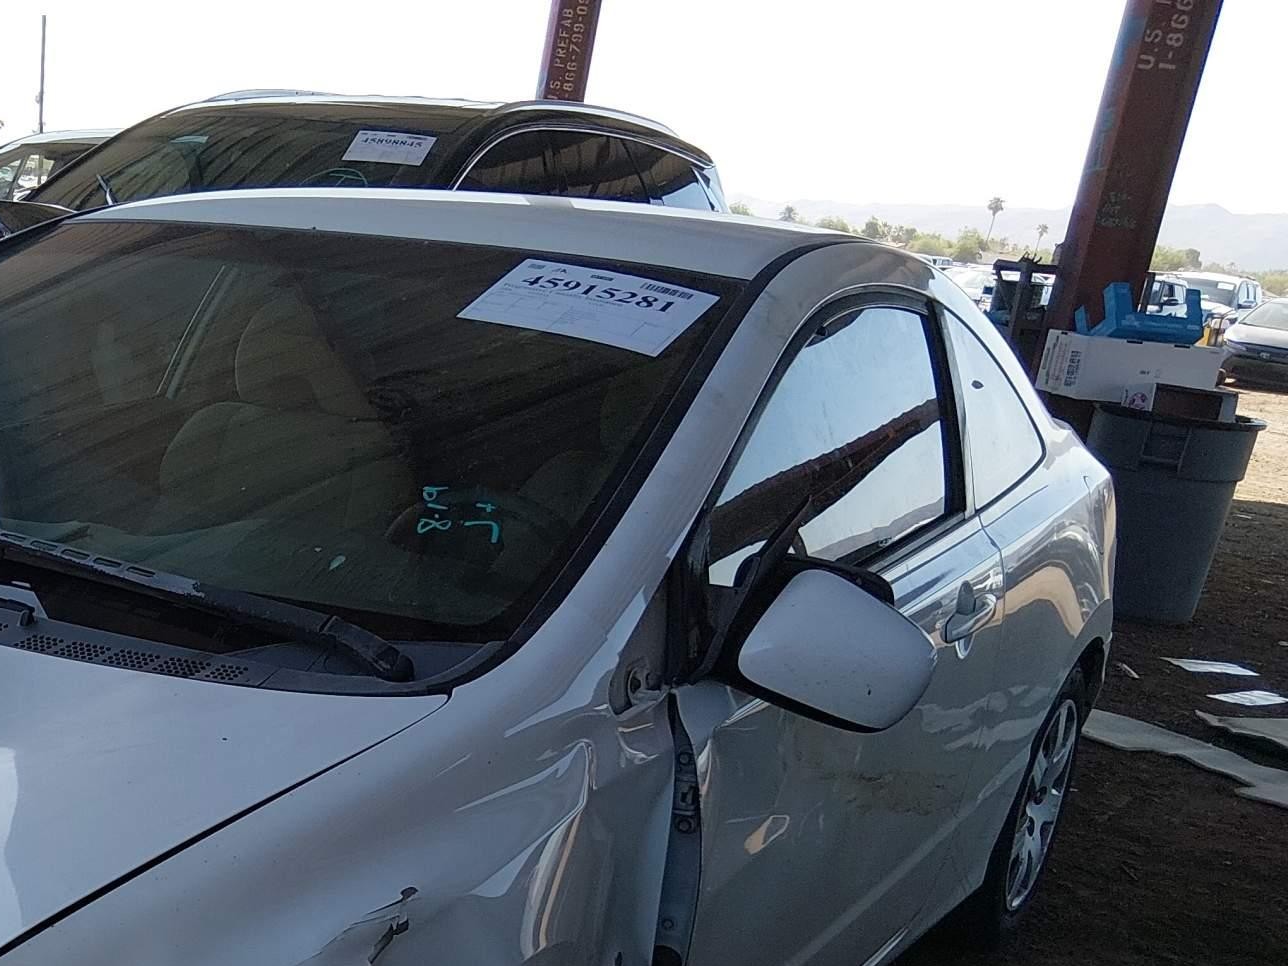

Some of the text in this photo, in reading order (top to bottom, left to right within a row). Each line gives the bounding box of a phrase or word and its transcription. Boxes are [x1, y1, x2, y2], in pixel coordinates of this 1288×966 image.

[554, 8, 574, 68] PREFAB
[521, 275, 675, 313] 45915281
[417, 486, 452, 534] 8.19
